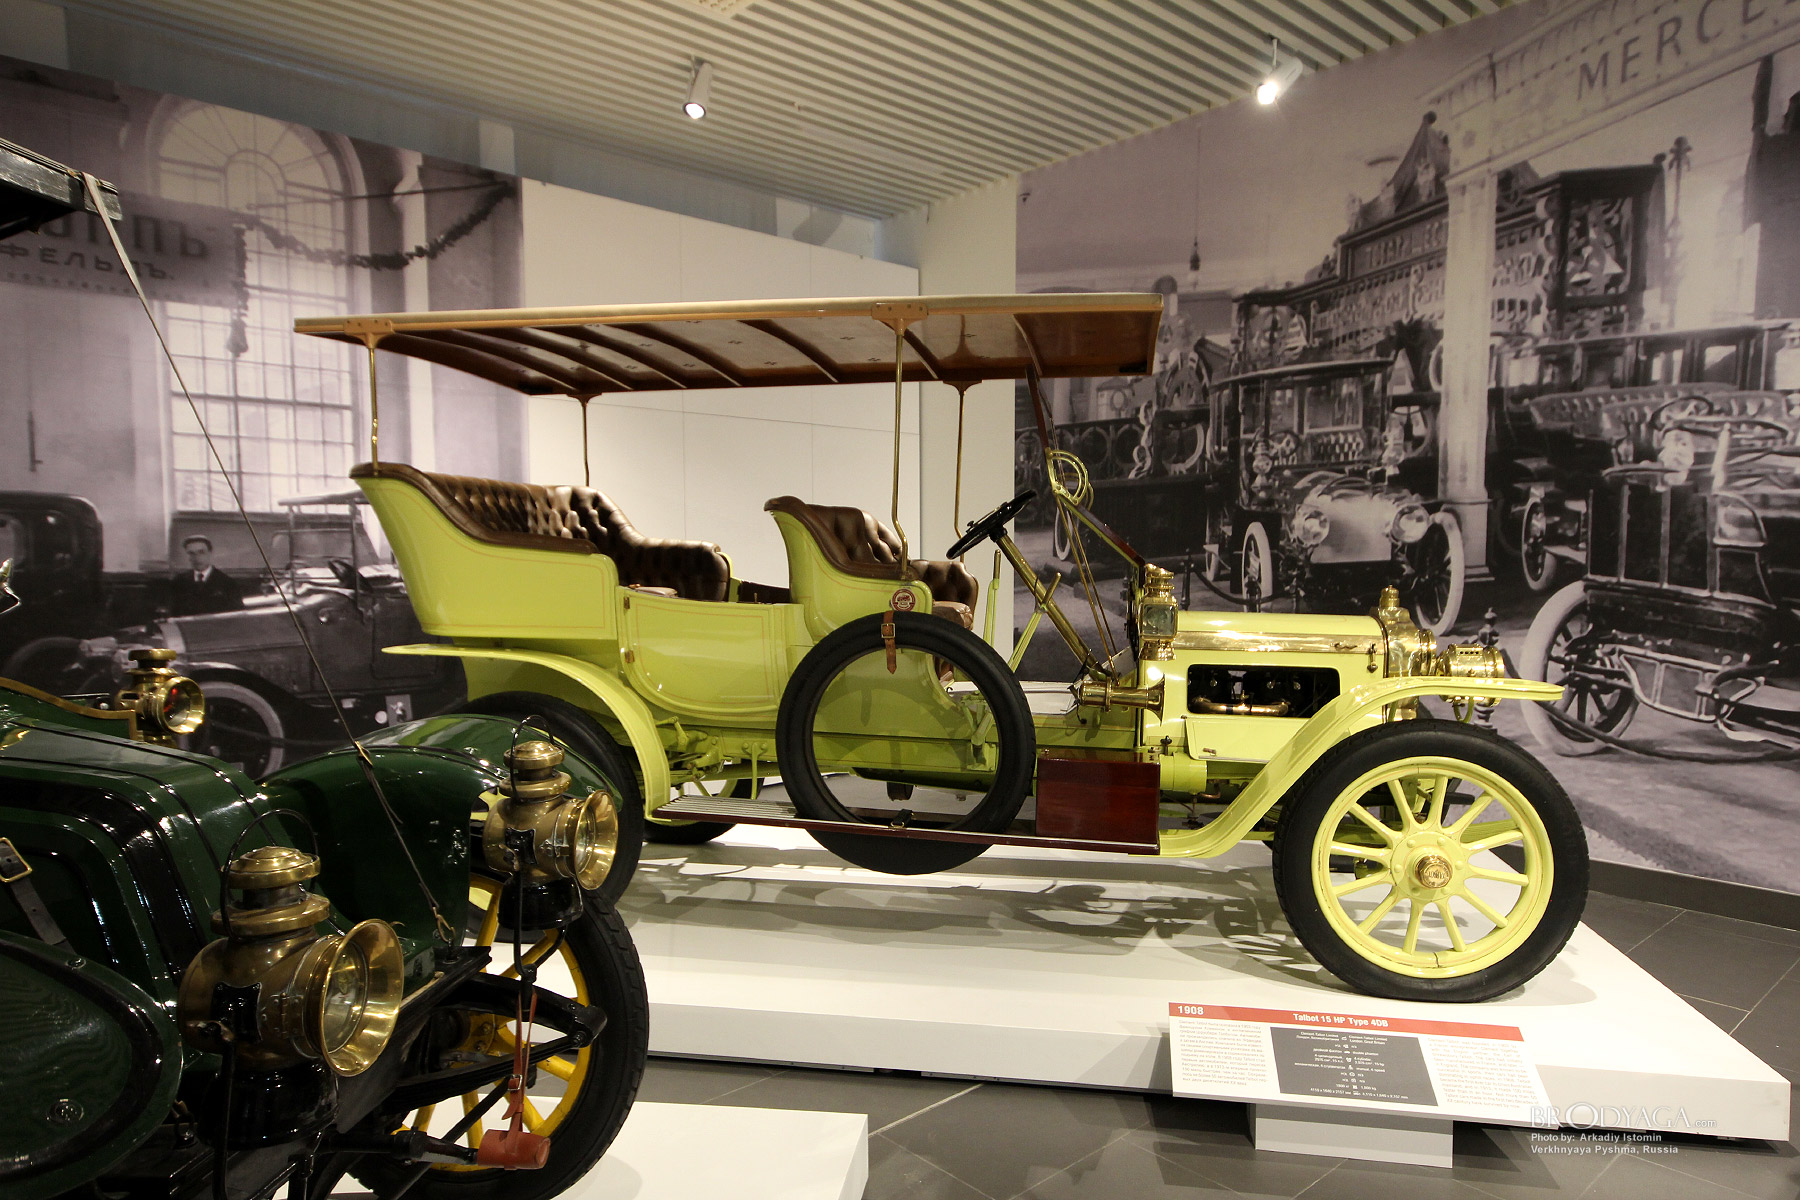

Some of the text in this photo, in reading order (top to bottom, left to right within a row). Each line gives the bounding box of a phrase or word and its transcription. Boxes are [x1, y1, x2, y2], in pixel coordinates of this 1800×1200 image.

[1177, 1005, 1204, 1016] 1908
[1292, 1013, 1319, 1023] Talbot
[1320, 1015, 1332, 1023] 15
[1333, 1016, 1346, 1024] HP
[1347, 1017, 1369, 1027] Type
